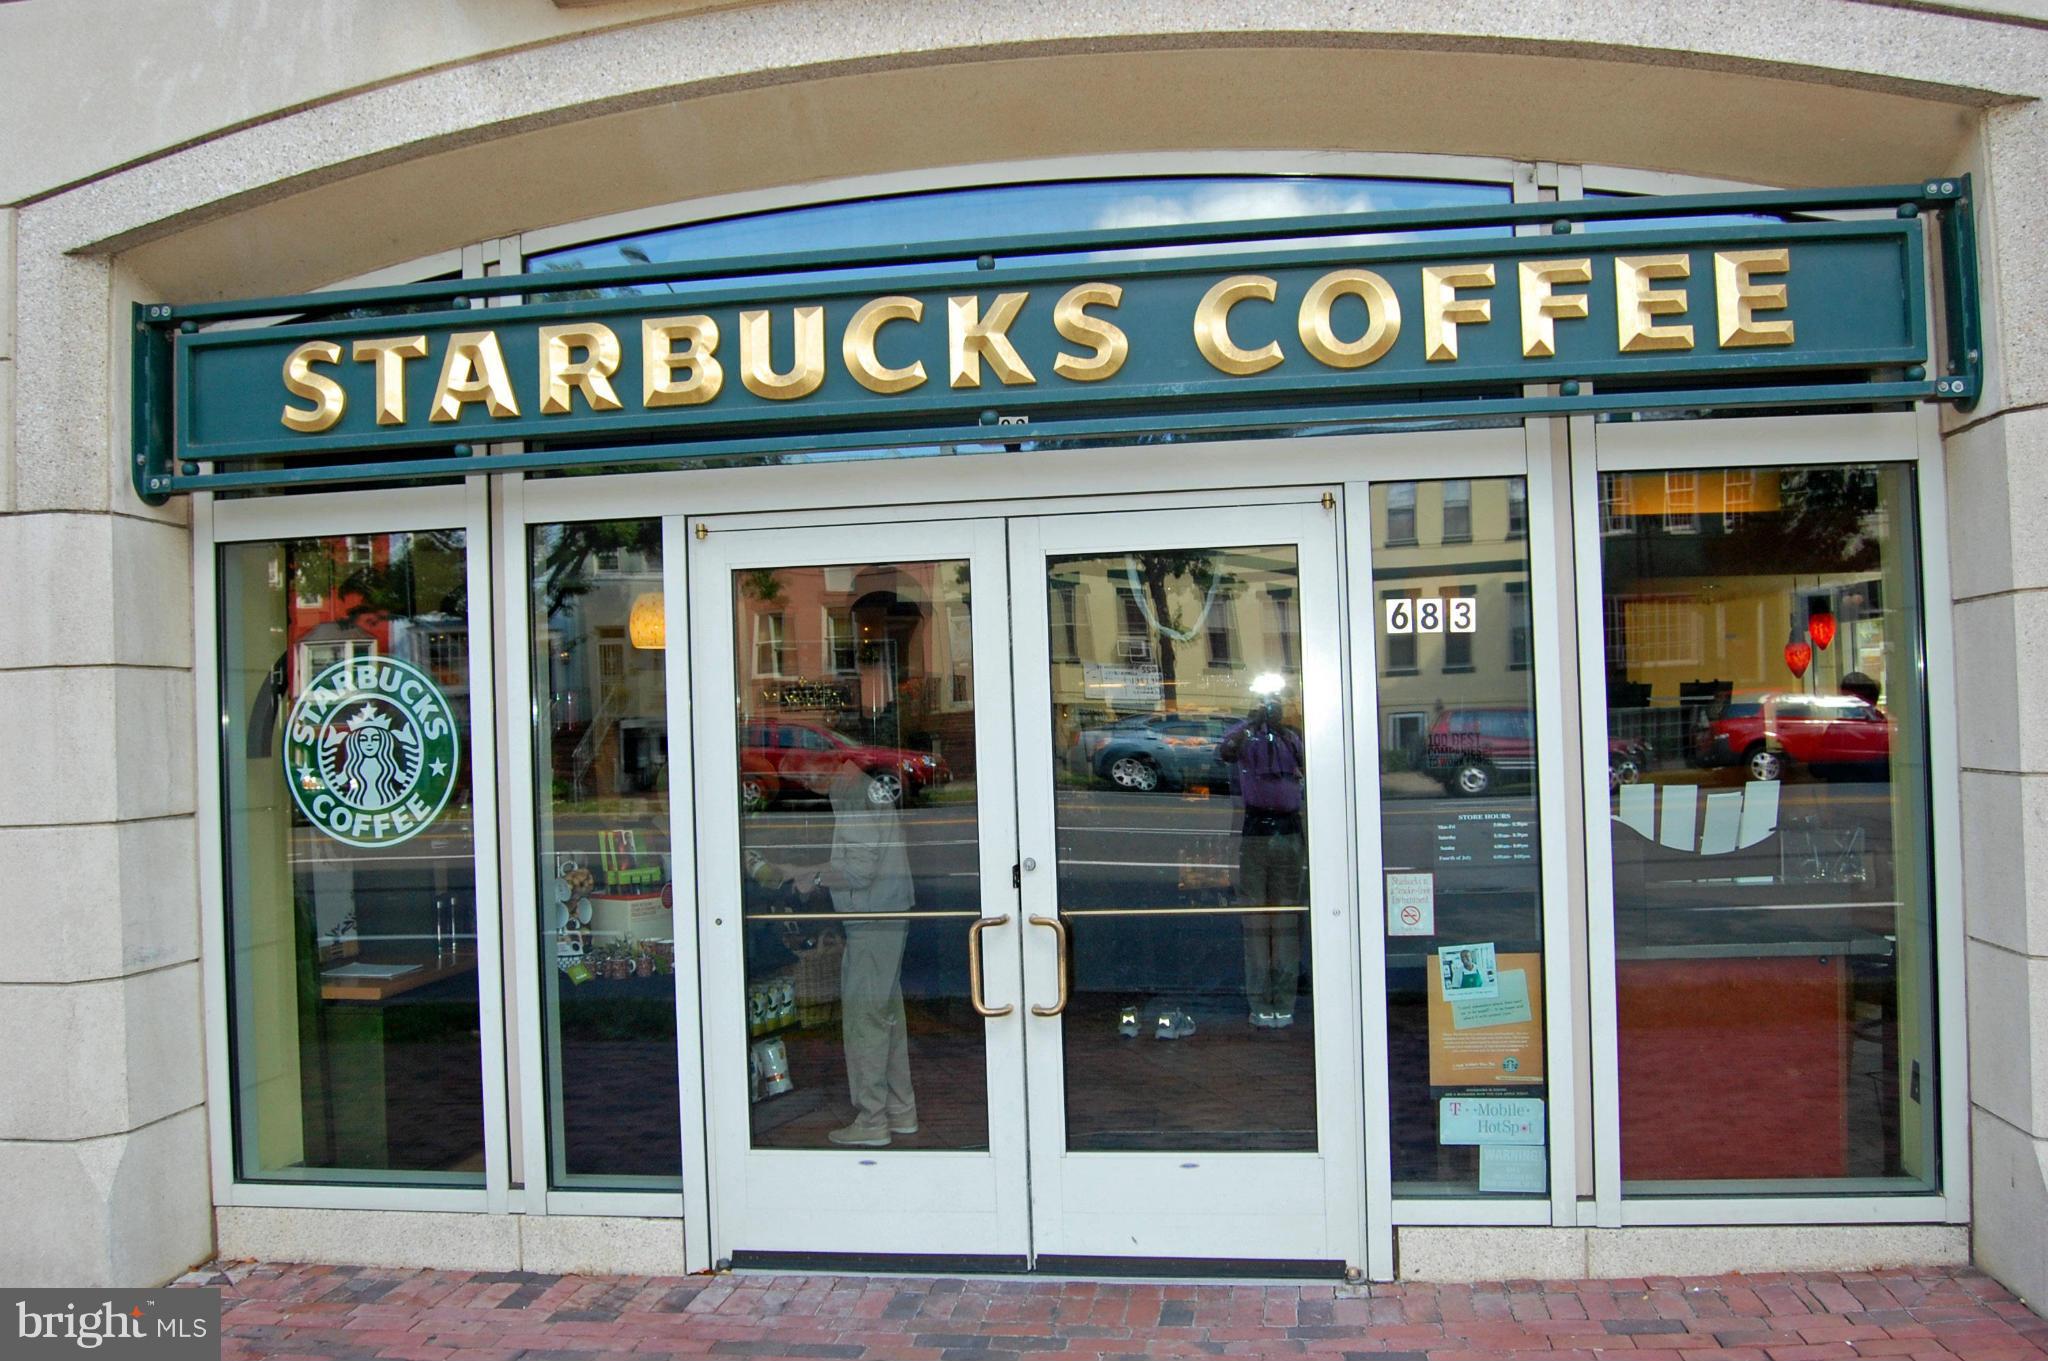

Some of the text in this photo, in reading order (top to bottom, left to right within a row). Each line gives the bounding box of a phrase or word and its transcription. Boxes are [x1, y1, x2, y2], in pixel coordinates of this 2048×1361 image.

[280, 247, 1797, 432] STARBUCKS COFFEE
[1390, 601, 1472, 631] 683
[292, 665, 450, 747] STARBUCKS
[1428, 732, 1480, 747] 100 BEST
[312, 792, 432, 839] COFFEE
